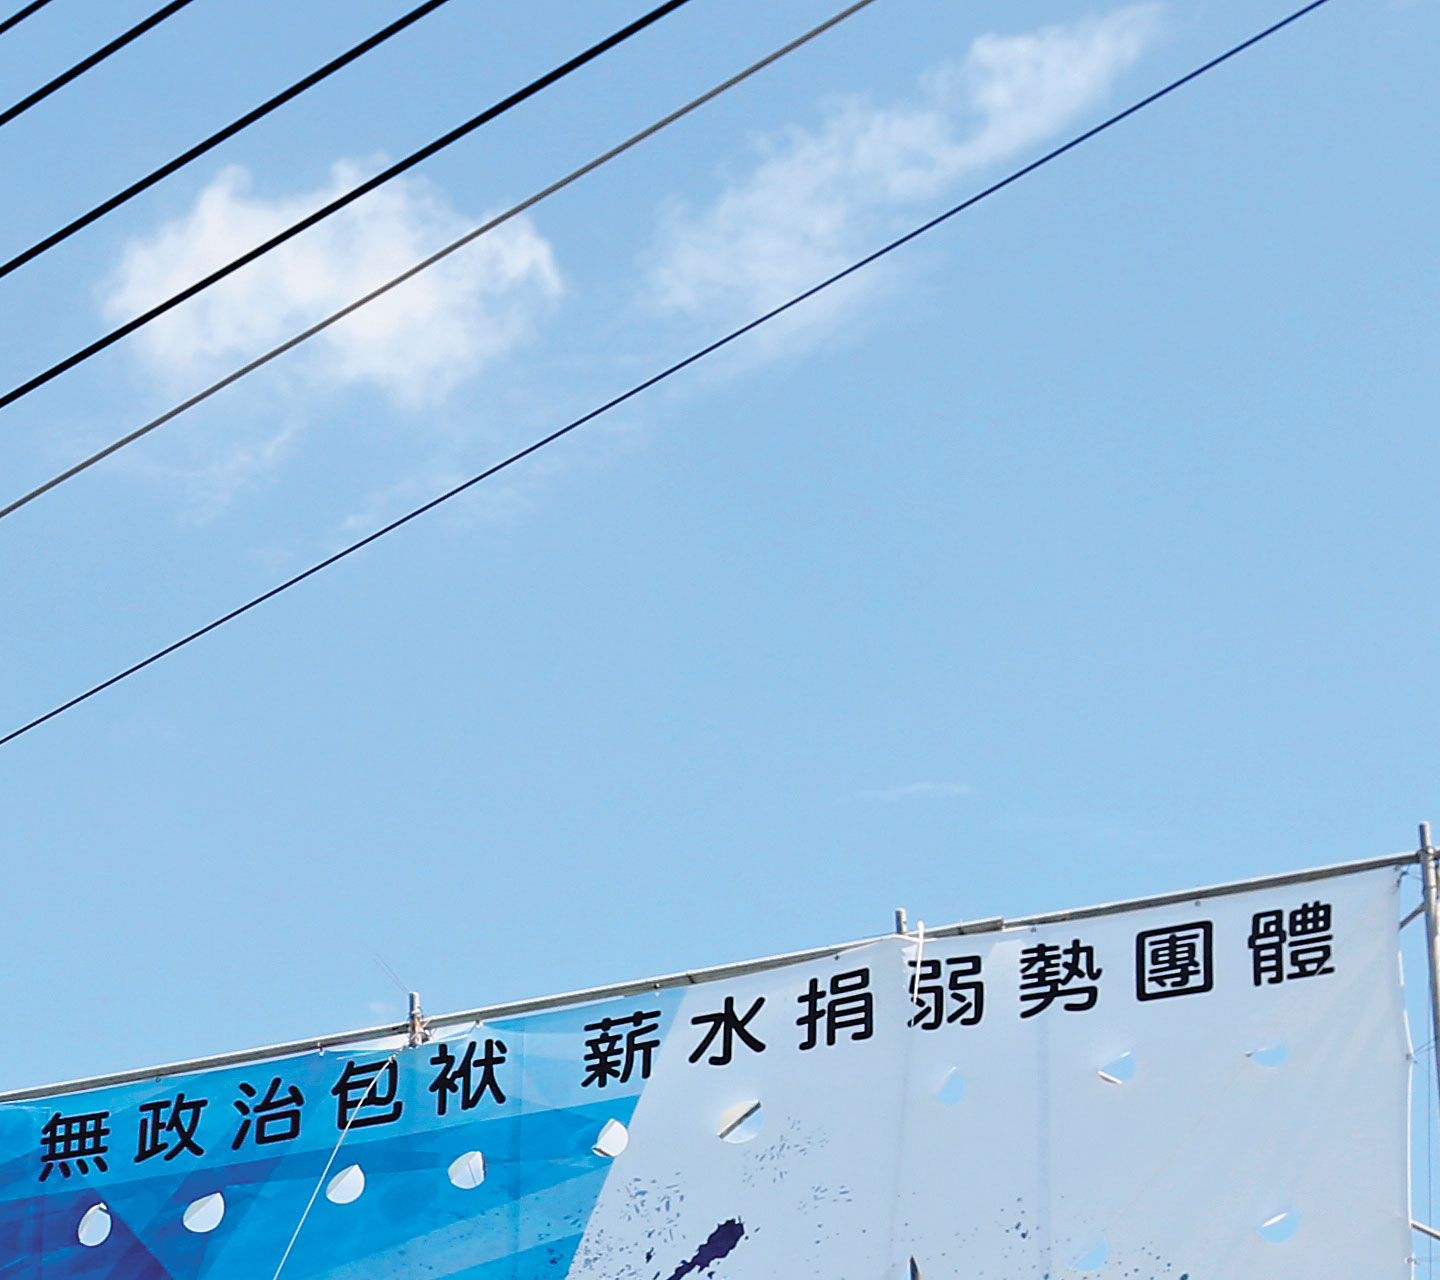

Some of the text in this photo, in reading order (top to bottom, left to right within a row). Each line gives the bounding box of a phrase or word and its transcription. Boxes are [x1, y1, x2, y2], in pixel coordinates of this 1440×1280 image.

[36, 1038, 508, 1184] 無政治包袱
[580, 900, 1335, 1089] 薪水捐弱勢團體
